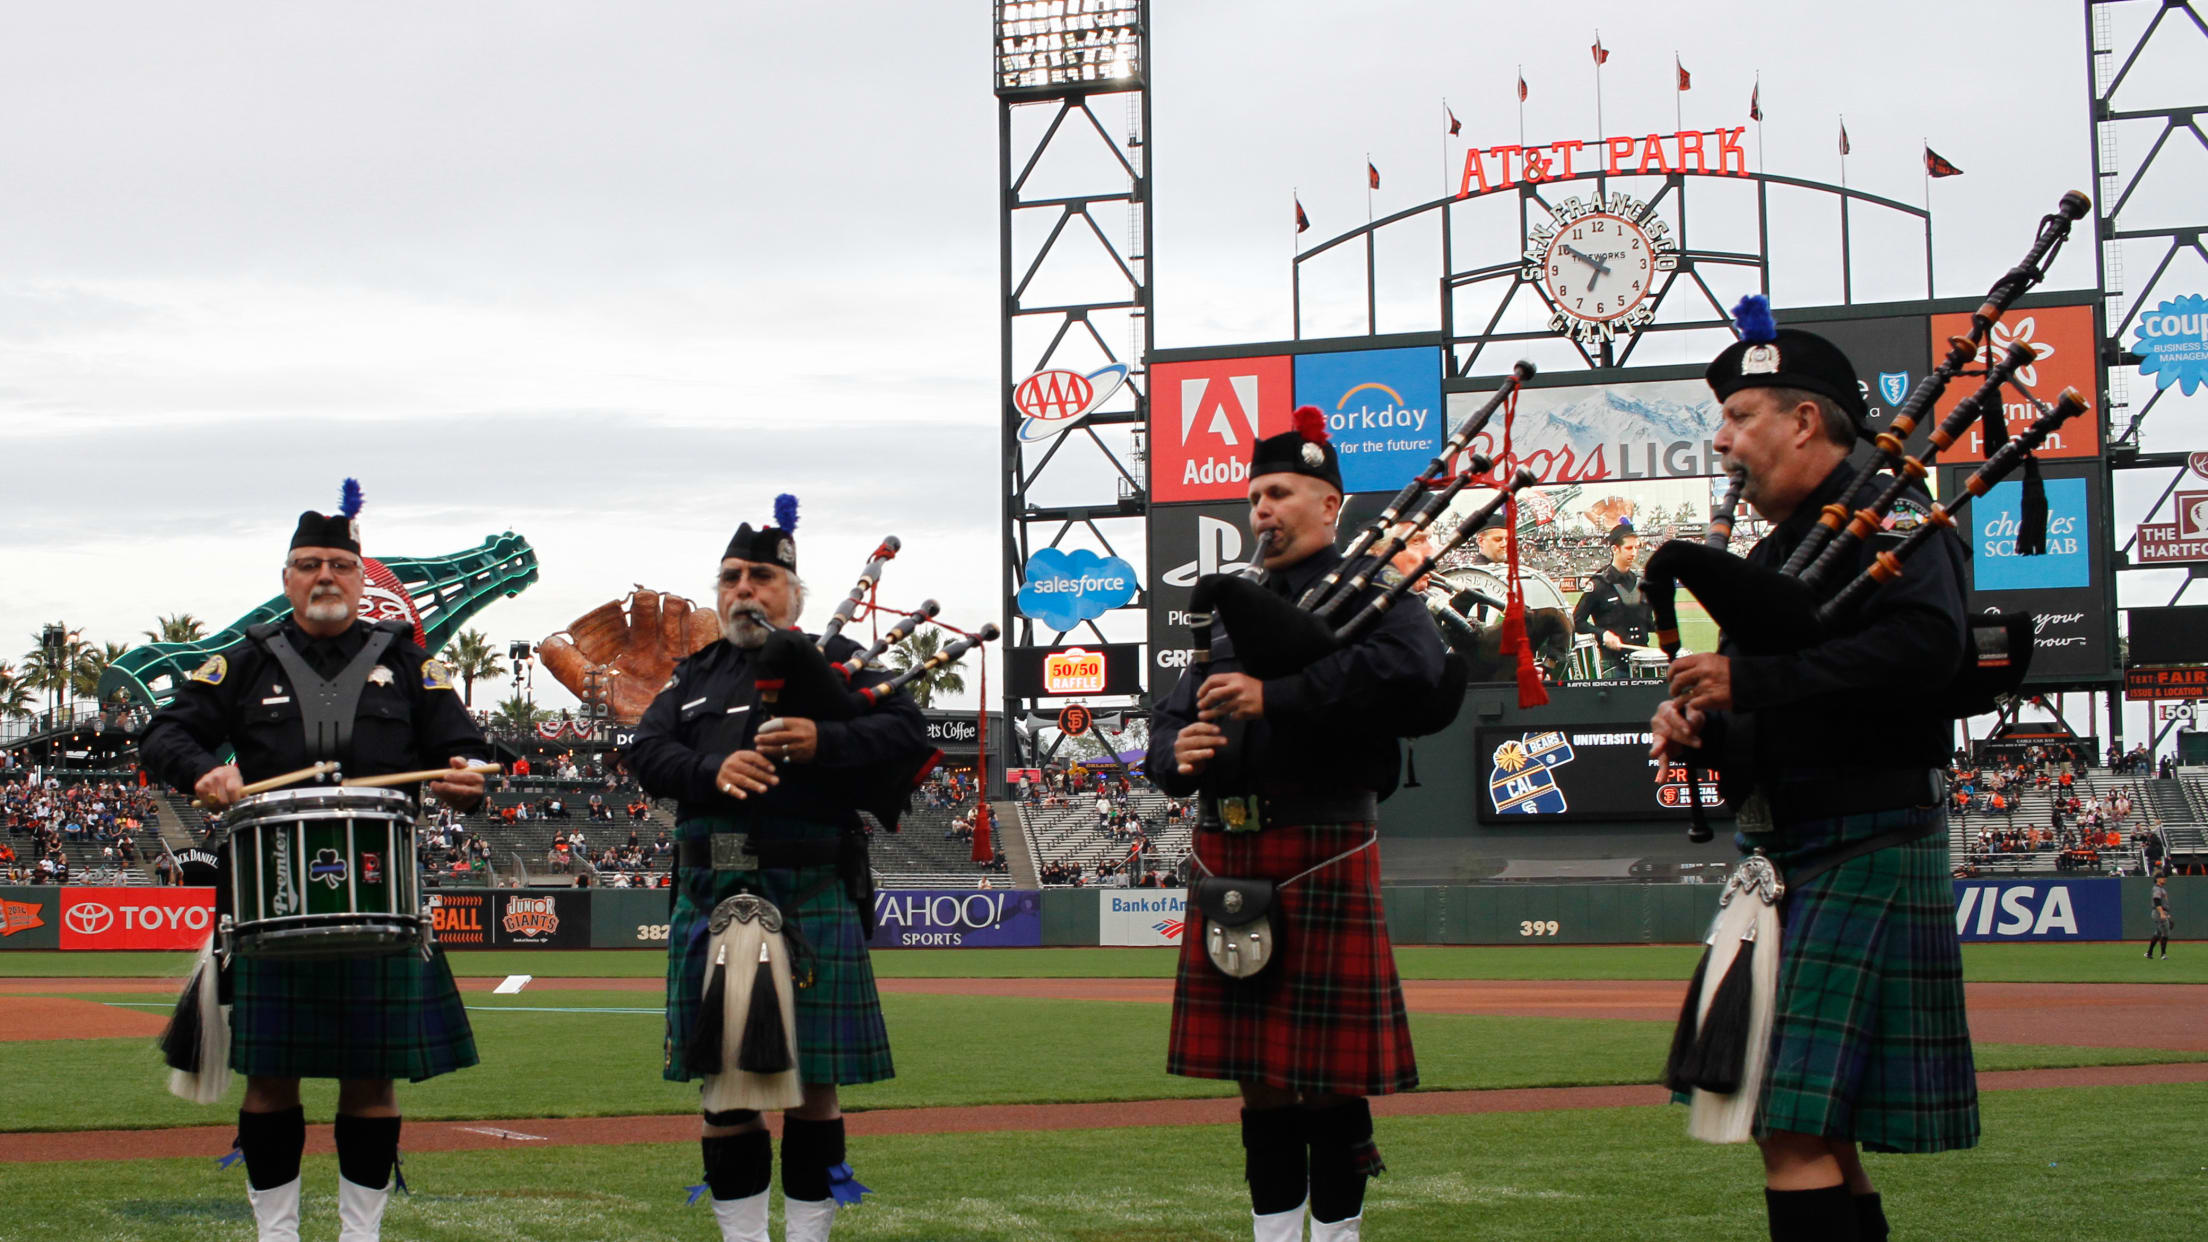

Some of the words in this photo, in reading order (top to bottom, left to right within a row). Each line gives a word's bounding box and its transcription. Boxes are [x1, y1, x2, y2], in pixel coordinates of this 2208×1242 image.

[1456, 139, 1583, 199] AT&T
[1605, 126, 1749, 177] PARK
[1572, 228, 1583, 240] 11
[1591, 221, 1605, 233] 12
[1617, 225, 1623, 236] 1
[1521, 223, 1554, 280] SAN
[1550, 191, 1678, 271] FRANCISCO
[1631, 238, 1640, 250] 2
[1572, 251, 1626, 262] TEWORKS
[1551, 265, 1559, 276] 9
[1639, 258, 1647, 270] 3
[1559, 285, 1567, 296] 8
[1631, 279, 1640, 291] 4
[1576, 297, 1584, 309] 7
[1617, 295, 1625, 306] 5
[1597, 302, 1604, 314] 6
[1547, 303, 1656, 343] GIANTS
[2153, 342, 2200, 352] BUSINESS
[1025, 372, 1086, 419] AAA
[1323, 404, 1428, 431] orkday
[1340, 440, 1360, 454] for
[1363, 440, 1383, 452] the
[1984, 510, 2076, 537] chles
[2142, 527, 2177, 541] THE
[1984, 537, 2078, 557] SCAB
[1033, 575, 1125, 597] salesforce
[1456, 575, 1481, 586] OSE
[2032, 613, 2084, 634] your
[1053, 663, 1099, 676] 50/50
[1052, 676, 1098, 688] RAFFLE
[2157, 671, 2208, 683] FAIR
[2130, 688, 2153, 697] ISSUE
[2164, 686, 2203, 697] LOCATION
[2165, 705, 2198, 720] 501
[942, 721, 975, 740] Coffee
[1529, 733, 1560, 753] BEARS
[1573, 733, 1639, 746] UNIVERSITY
[1506, 775, 1538, 798] CAL
[1680, 795, 1718, 804] EVTS
[273, 827, 289, 915] Premier
[509, 898, 553, 914] JUNIOR
[1112, 898, 1149, 912] Bank
[1151, 897, 1168, 912] of
[433, 908, 483, 930] BALL
[506, 914, 555, 930] GIANTS
[637, 925, 670, 940] 382
[1520, 920, 1559, 936] 399
[902, 933, 962, 945] SPORTS
